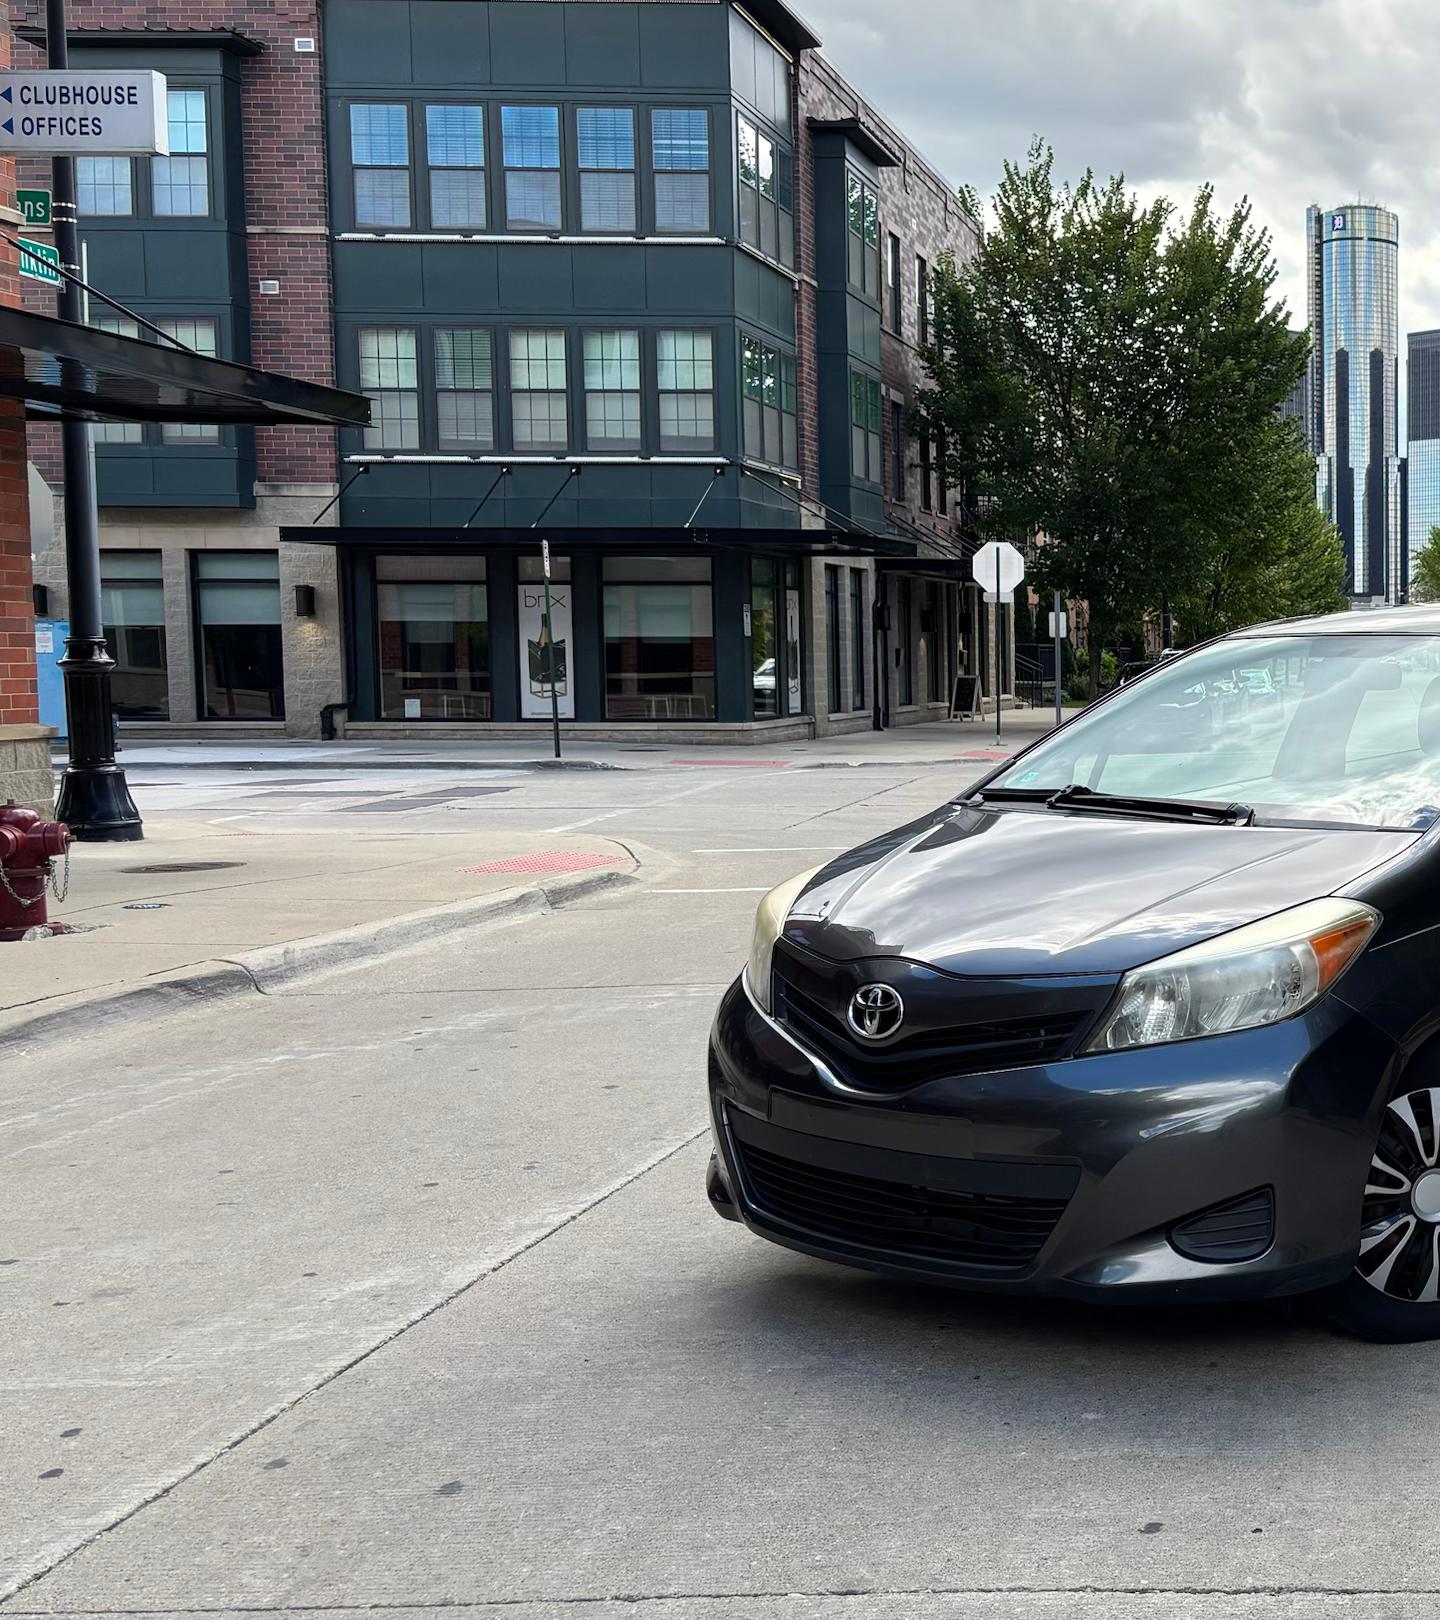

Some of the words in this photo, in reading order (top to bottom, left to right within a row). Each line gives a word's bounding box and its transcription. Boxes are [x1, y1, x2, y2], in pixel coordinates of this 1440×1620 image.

[20, 86, 138, 105] CLUBHOUSE
[21, 116, 102, 136] OFFICES
[524, 588, 567, 608] brx
